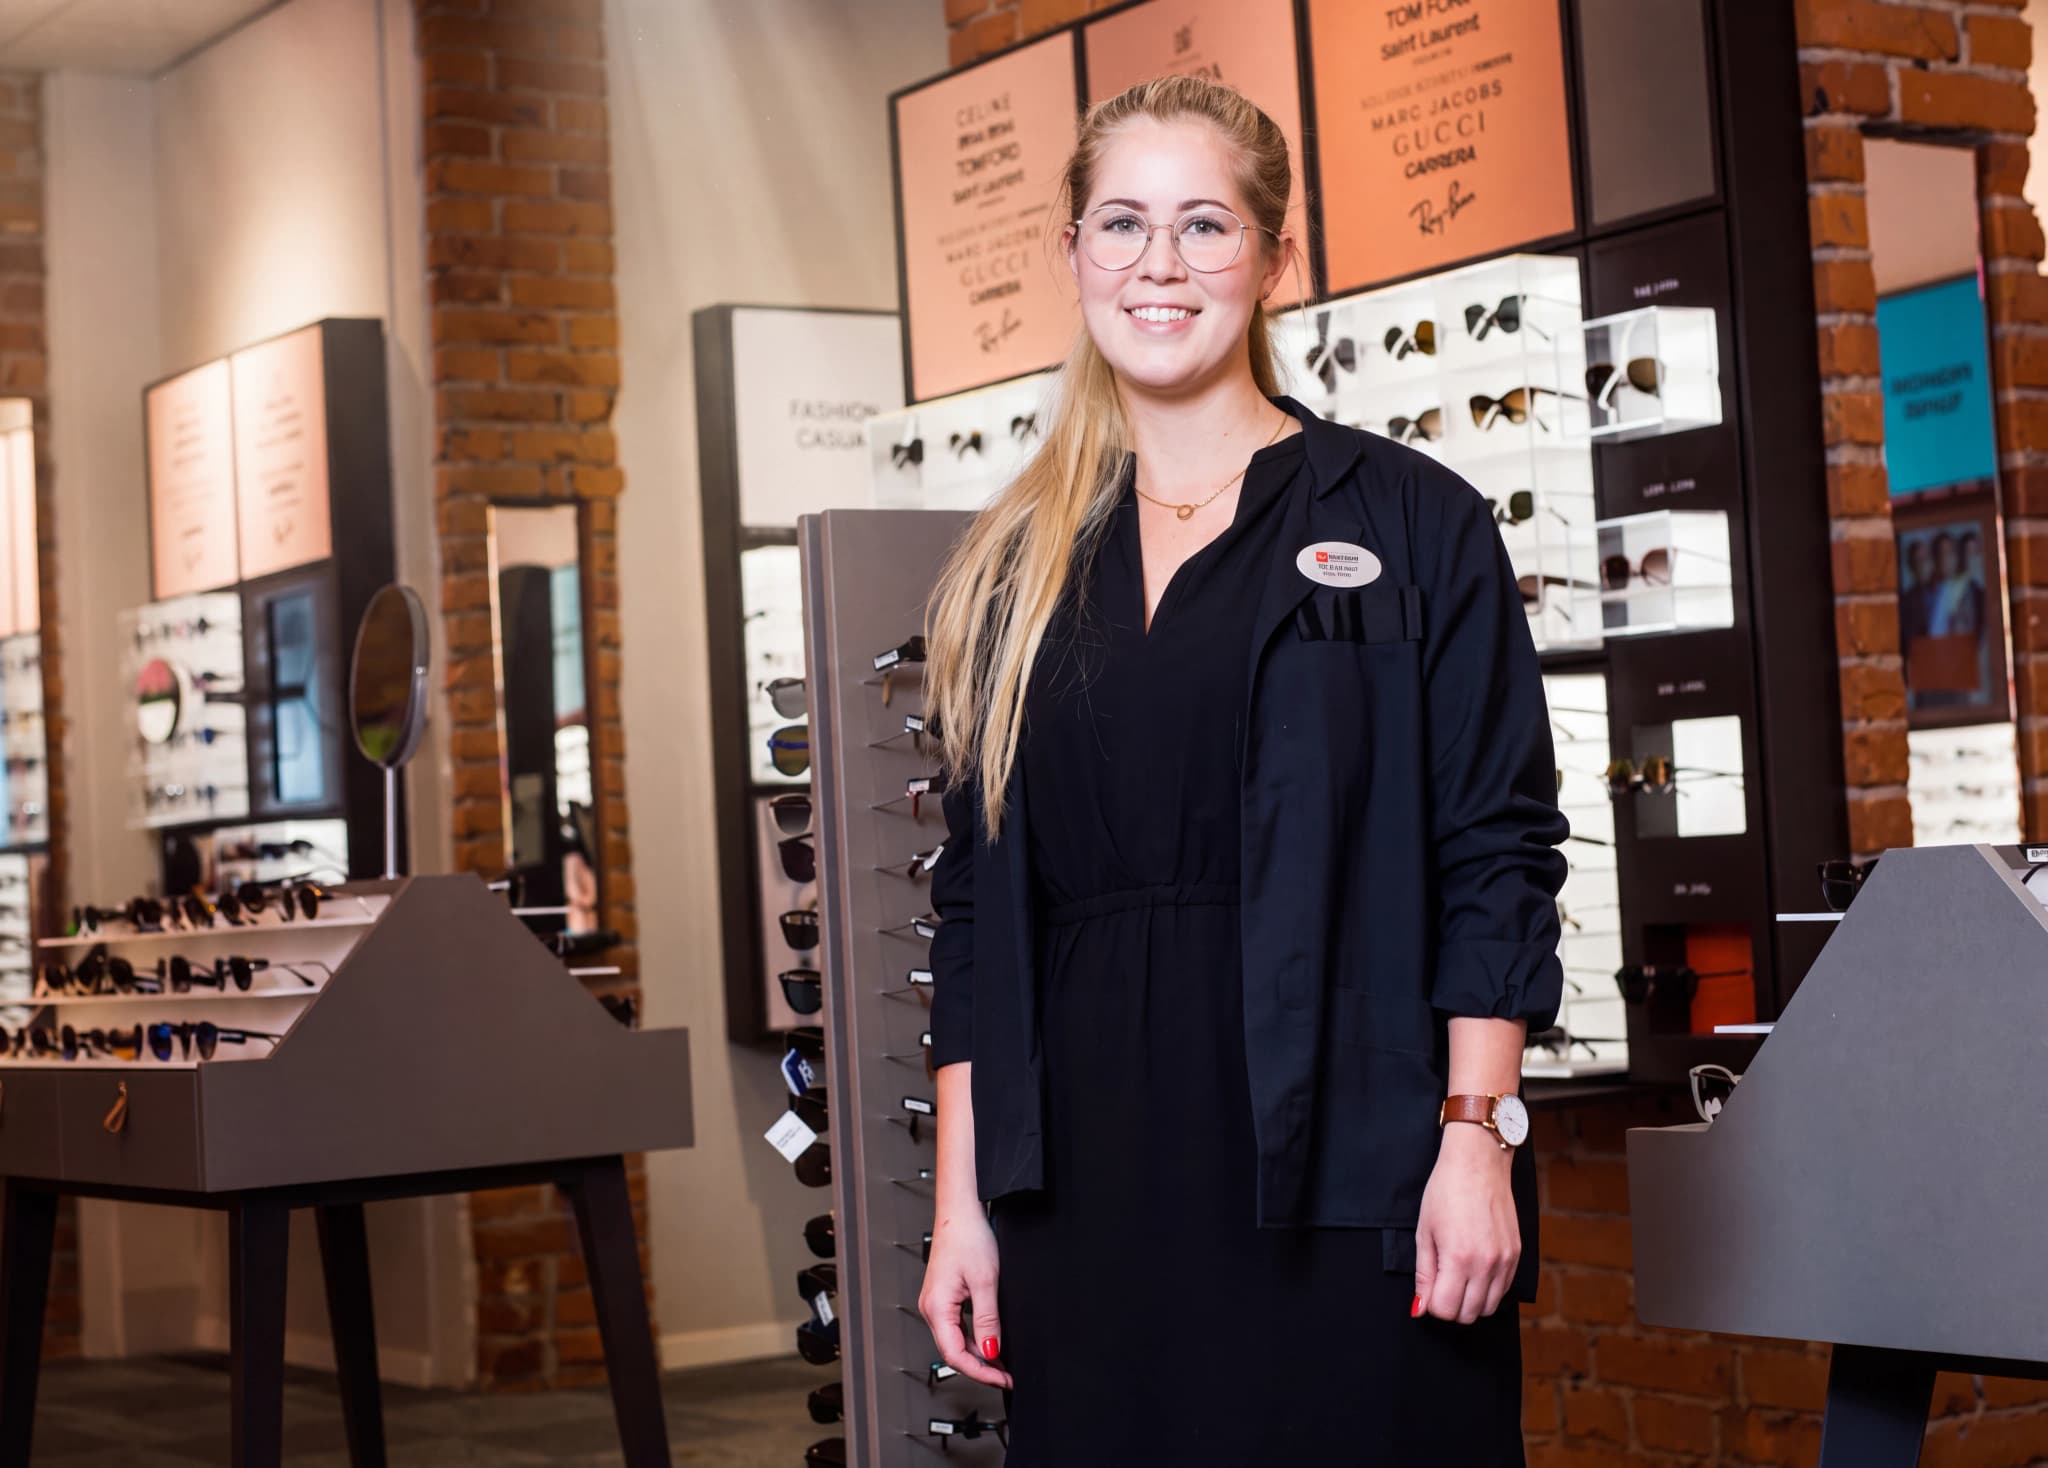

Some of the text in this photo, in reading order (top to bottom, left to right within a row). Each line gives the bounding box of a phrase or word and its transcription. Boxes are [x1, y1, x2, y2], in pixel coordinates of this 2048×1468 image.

[1381, 33, 1416, 61] Saint
[1420, 12, 1479, 48] Laurent
[1386, 0, 1421, 29] TOM
[1371, 104, 1421, 132] MARC
[1429, 78, 1503, 117] JACOBS
[1392, 110, 1486, 157] GUCCI
[1404, 144, 1477, 179] CARRERA
